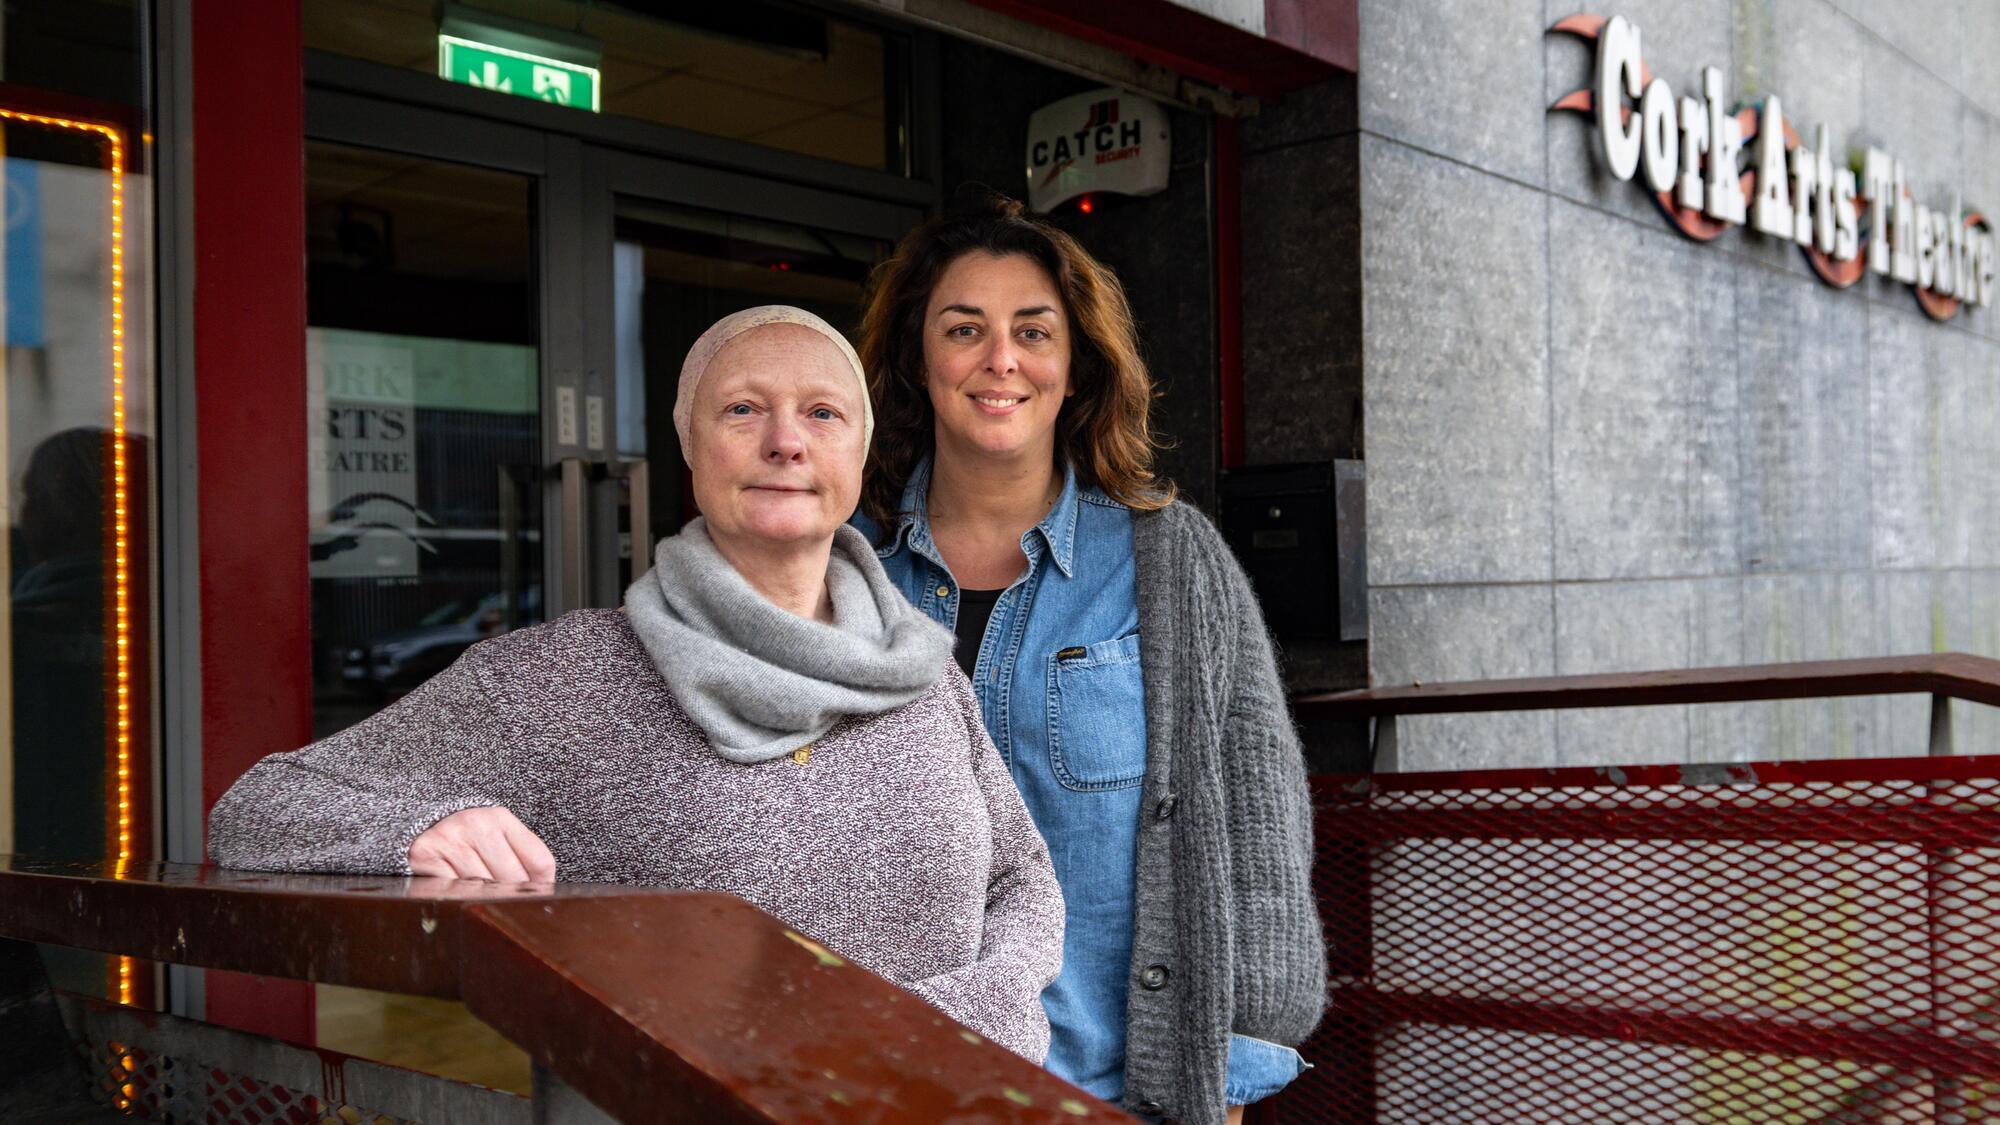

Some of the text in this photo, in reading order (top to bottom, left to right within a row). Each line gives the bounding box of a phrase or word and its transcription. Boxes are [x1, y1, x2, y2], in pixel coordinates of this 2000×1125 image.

[1032, 119, 1141, 167] CATCH
[1094, 146, 1141, 165] SECURITY
[1599, 14, 1995, 307] Cork Arts Theatre
[307, 362, 409, 398] ORK
[310, 406, 407, 441] RTS
